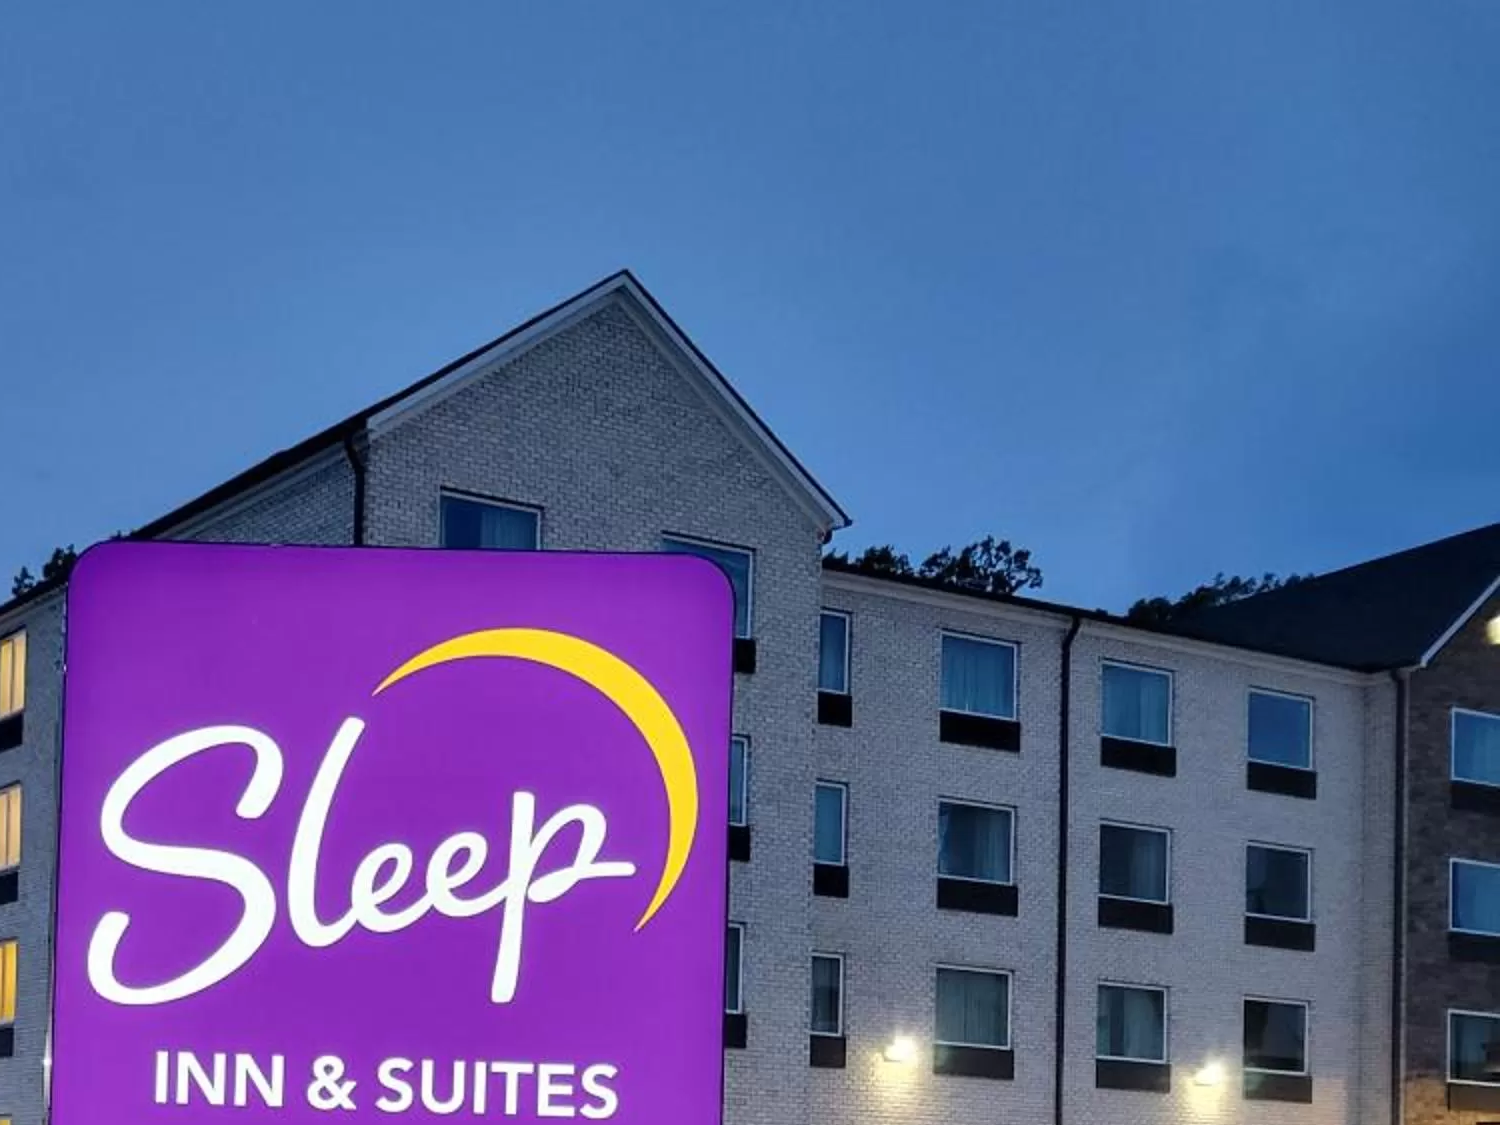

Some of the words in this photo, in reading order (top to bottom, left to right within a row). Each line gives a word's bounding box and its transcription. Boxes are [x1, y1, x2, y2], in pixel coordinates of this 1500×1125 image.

[87, 716, 636, 1005] Sleep
[155, 1051, 285, 1107] INN
[307, 1055, 357, 1110] &
[376, 1057, 619, 1119] SUITES
